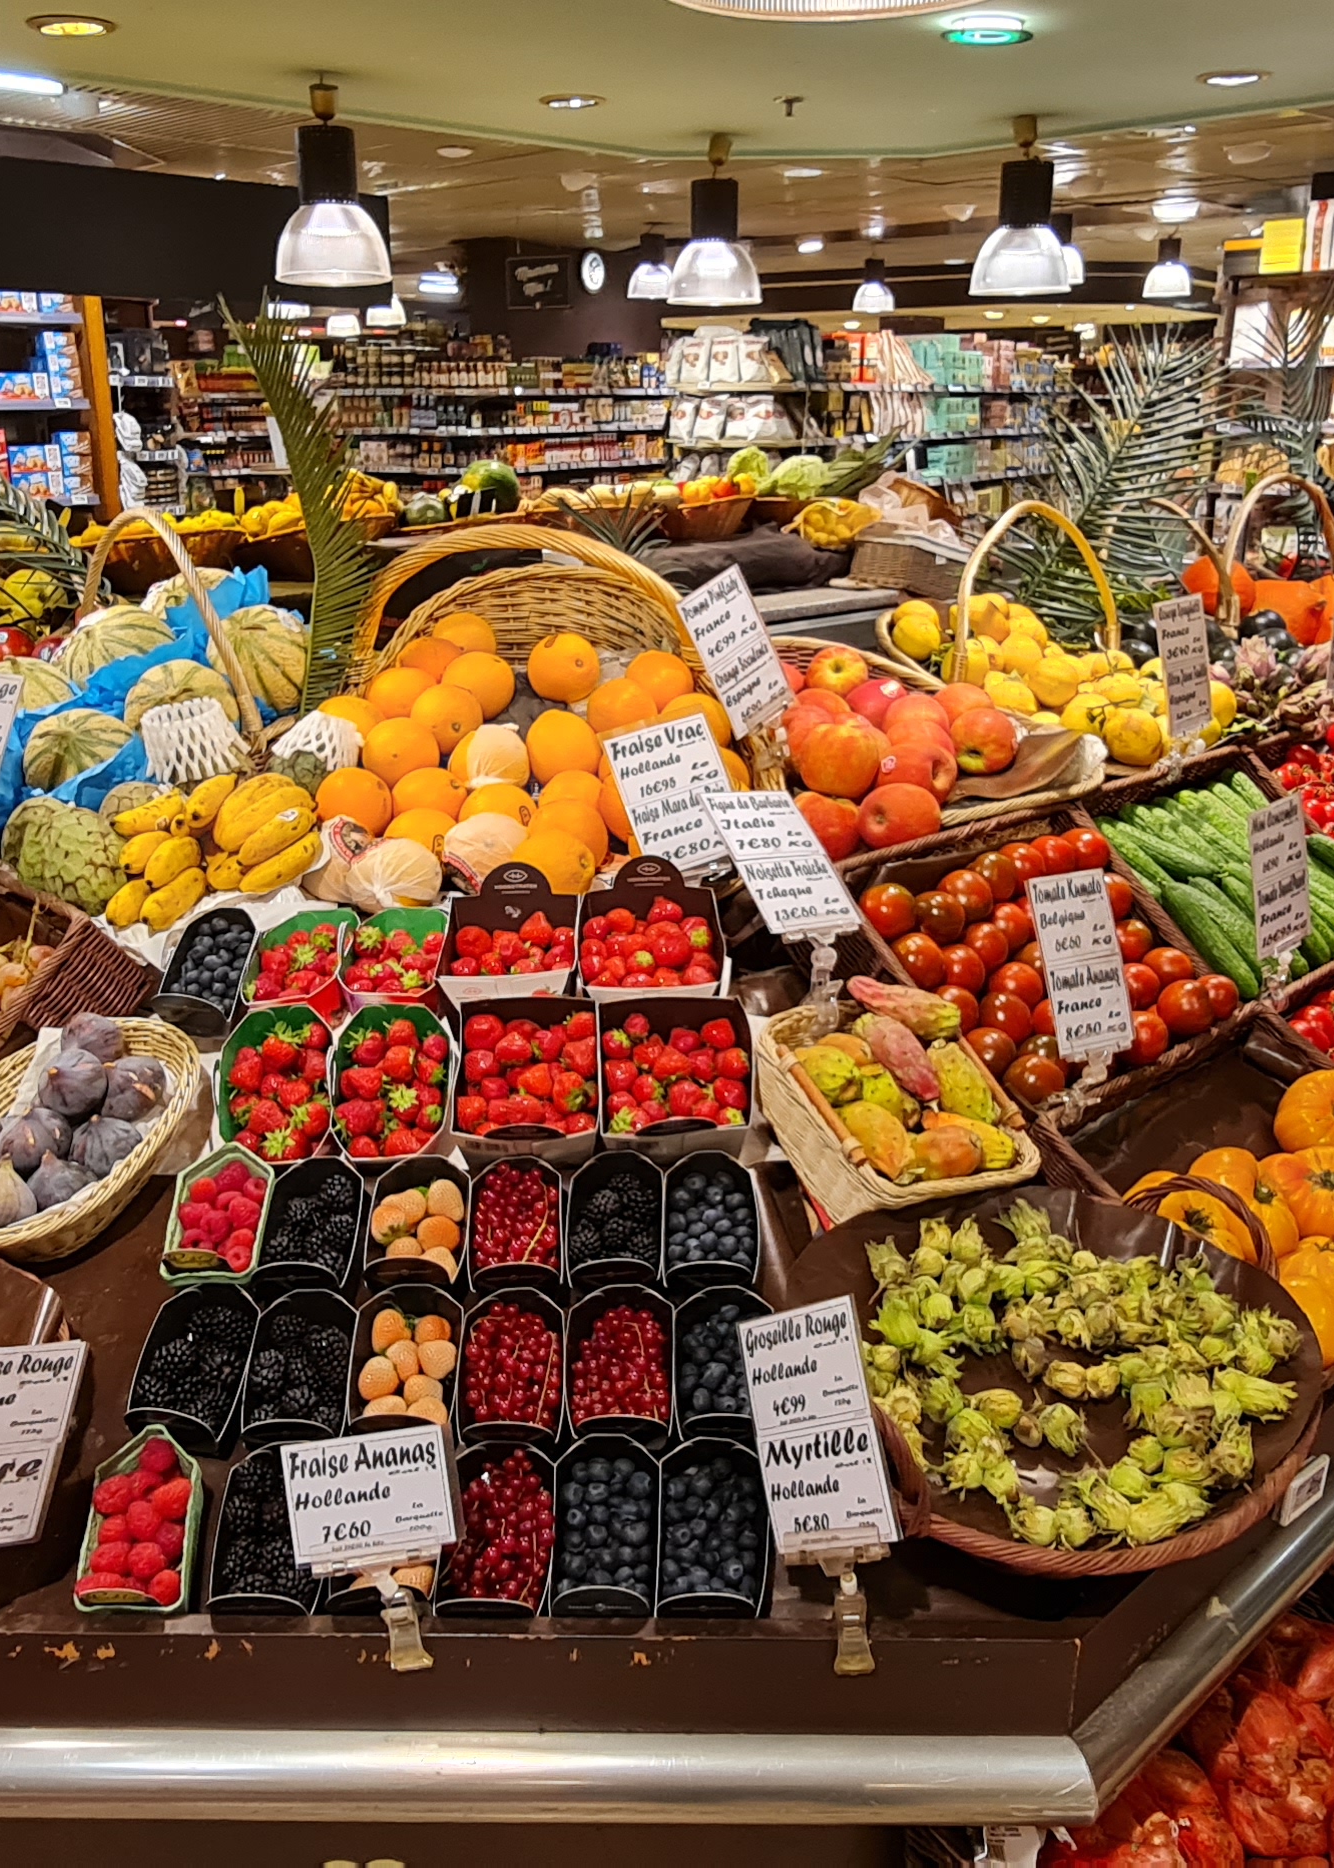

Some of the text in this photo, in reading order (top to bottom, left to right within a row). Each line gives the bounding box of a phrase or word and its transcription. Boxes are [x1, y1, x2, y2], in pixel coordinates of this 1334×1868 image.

[693, 610, 731, 641] France
[610, 723, 704, 762] Fraise Vrac
[620, 752, 681, 780] Hollande
[642, 818, 703, 846] France
[735, 837, 782, 850] 7€80
[744, 861, 792, 883] Noisette
[1039, 909, 1086, 930] Belgique
[1057, 997, 1102, 1015] France
[746, 1312, 847, 1358] Groseille Rouge
[17, 1354, 74, 1378] Rouge
[752, 1355, 817, 1386] Hollande
[773, 1394, 806, 1416] 4€99
[289, 1441, 436, 1480] Fraise Ananas
[765, 1427, 869, 1470] Myrtille
[295, 1481, 391, 1511] Hollande
[771, 1474, 840, 1502] Hollande
[322, 1519, 371, 1544] 7€60
[793, 1513, 830, 1534] 5€80
